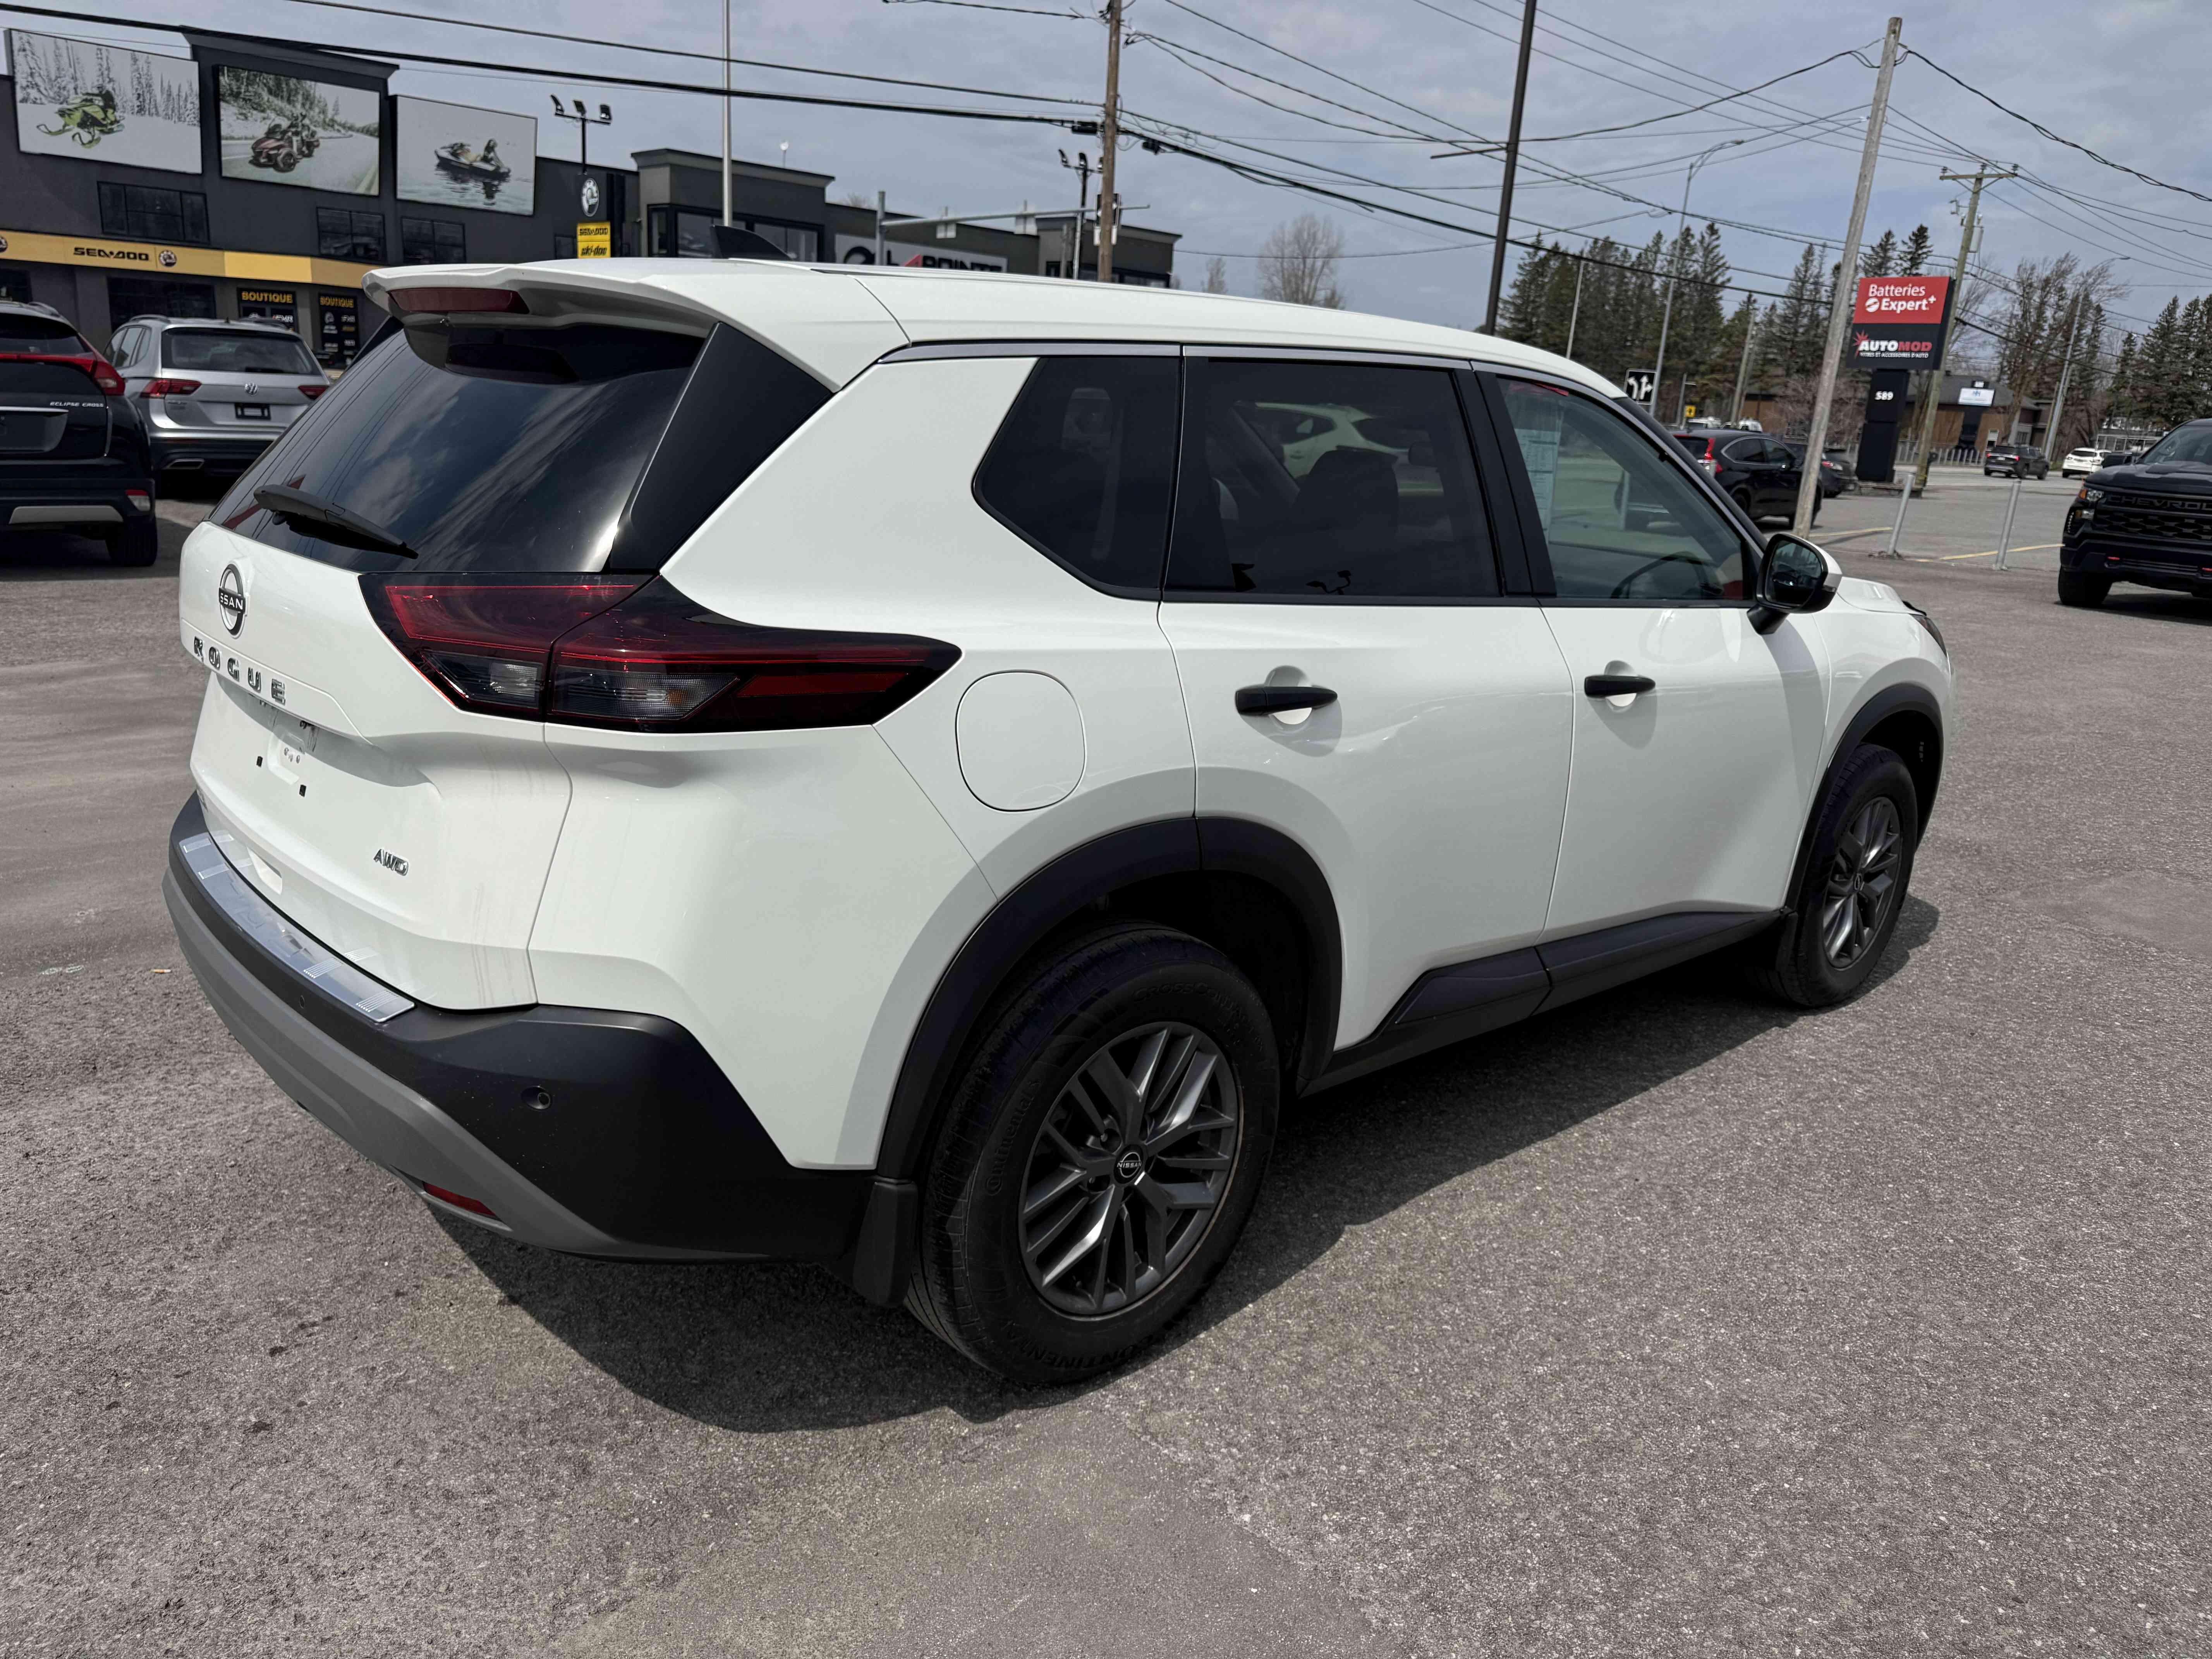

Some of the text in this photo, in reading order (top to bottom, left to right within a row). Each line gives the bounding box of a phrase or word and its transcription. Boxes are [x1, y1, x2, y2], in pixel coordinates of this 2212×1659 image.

[1868, 283, 1925, 297] Batteries
[242, 291, 293, 303] BOUTIQUE
[320, 296, 354, 308] BOUTIQUE
[1859, 340, 1932, 352] AUTOMOD
[1875, 391, 1894, 400] 589
[220, 592, 243, 610] SSAN
[194, 636, 286, 706] ROGUE
[373, 848, 409, 876] AWD
